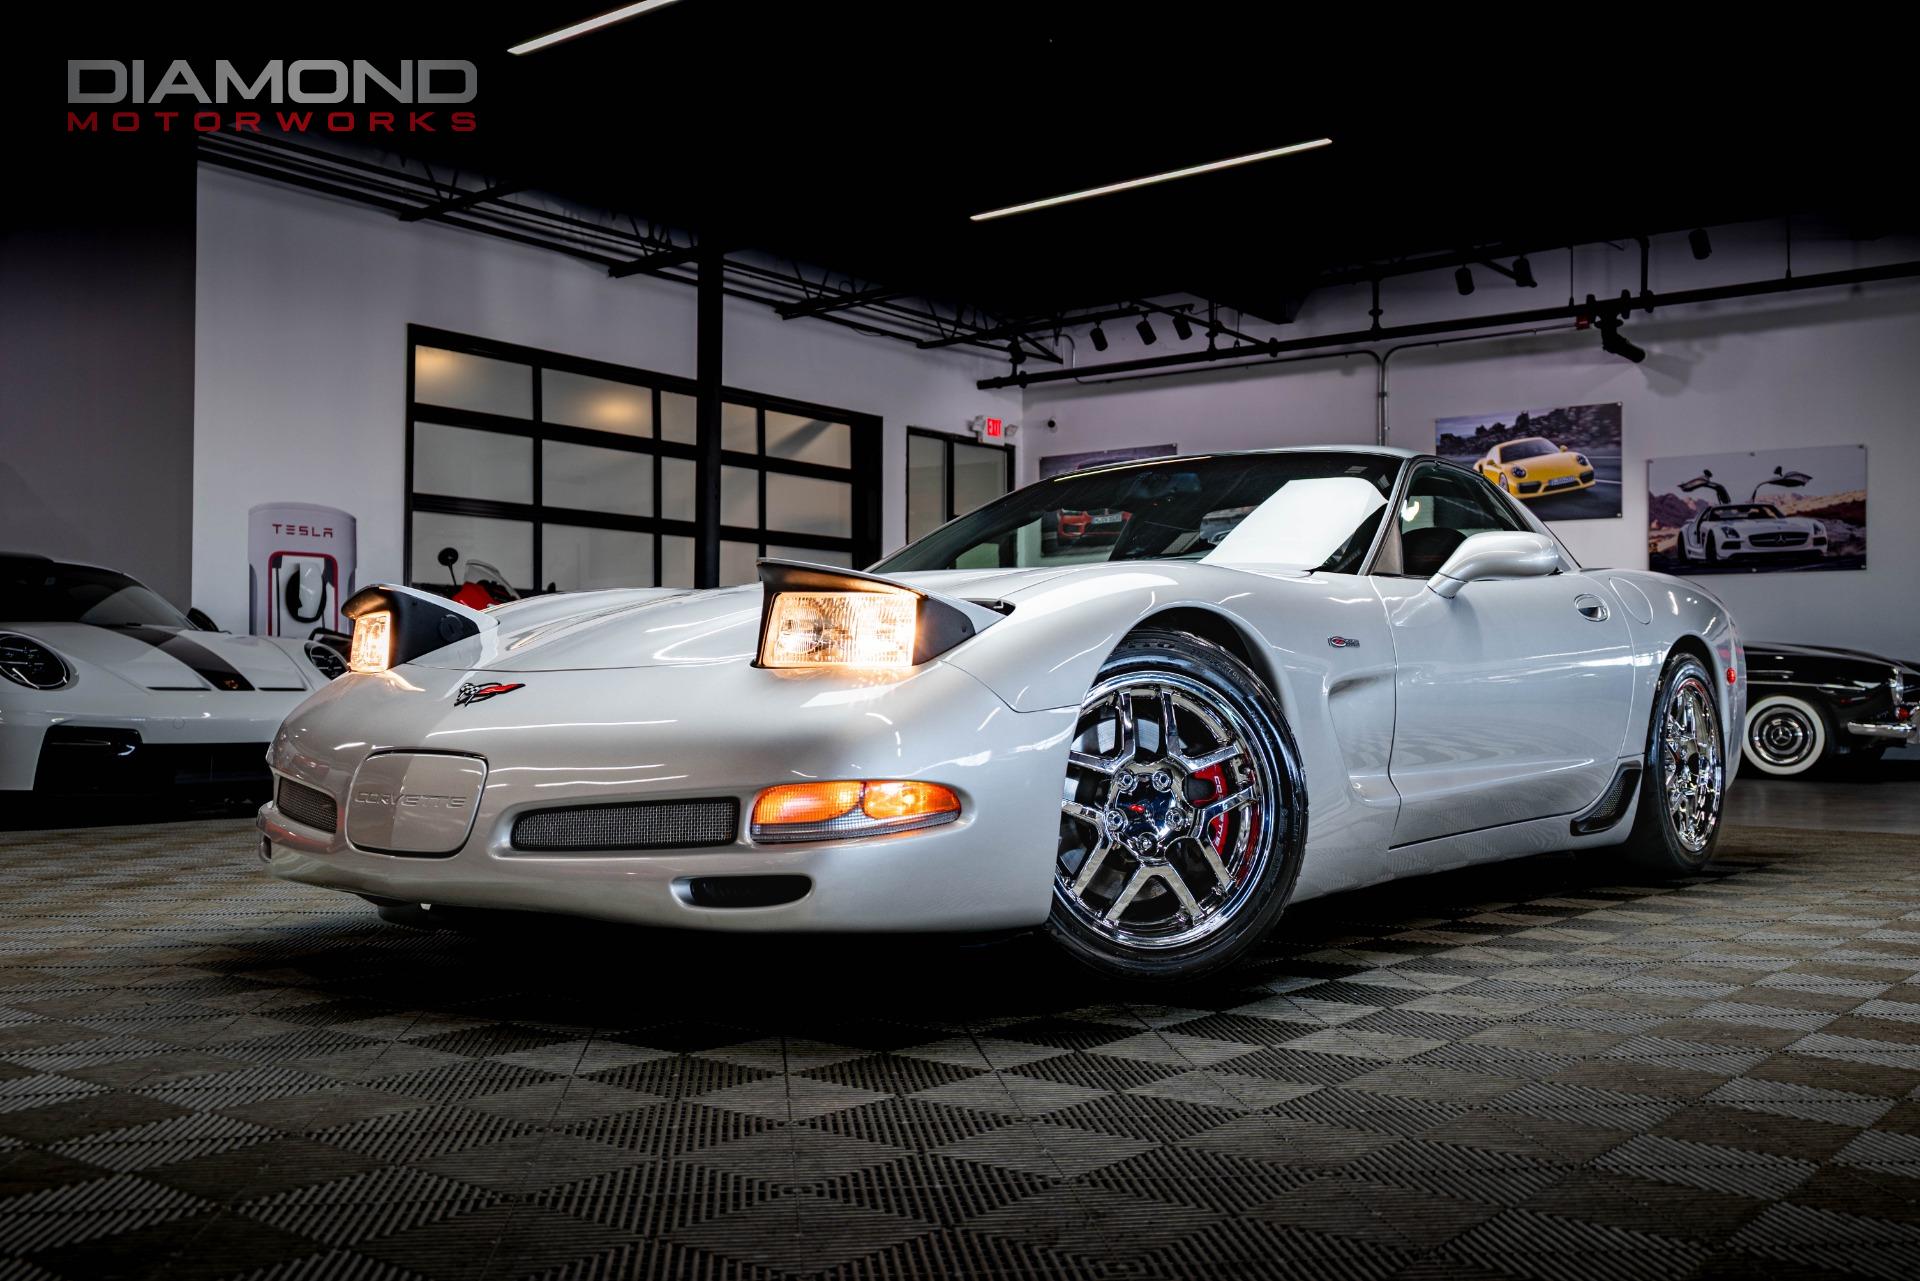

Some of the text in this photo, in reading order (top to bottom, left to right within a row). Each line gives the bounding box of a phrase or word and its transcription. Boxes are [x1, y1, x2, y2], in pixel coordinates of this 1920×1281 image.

[987, 417, 1002, 437] EXIT
[272, 523, 333, 538] TESLA
[354, 791, 467, 809] CORVETTE
